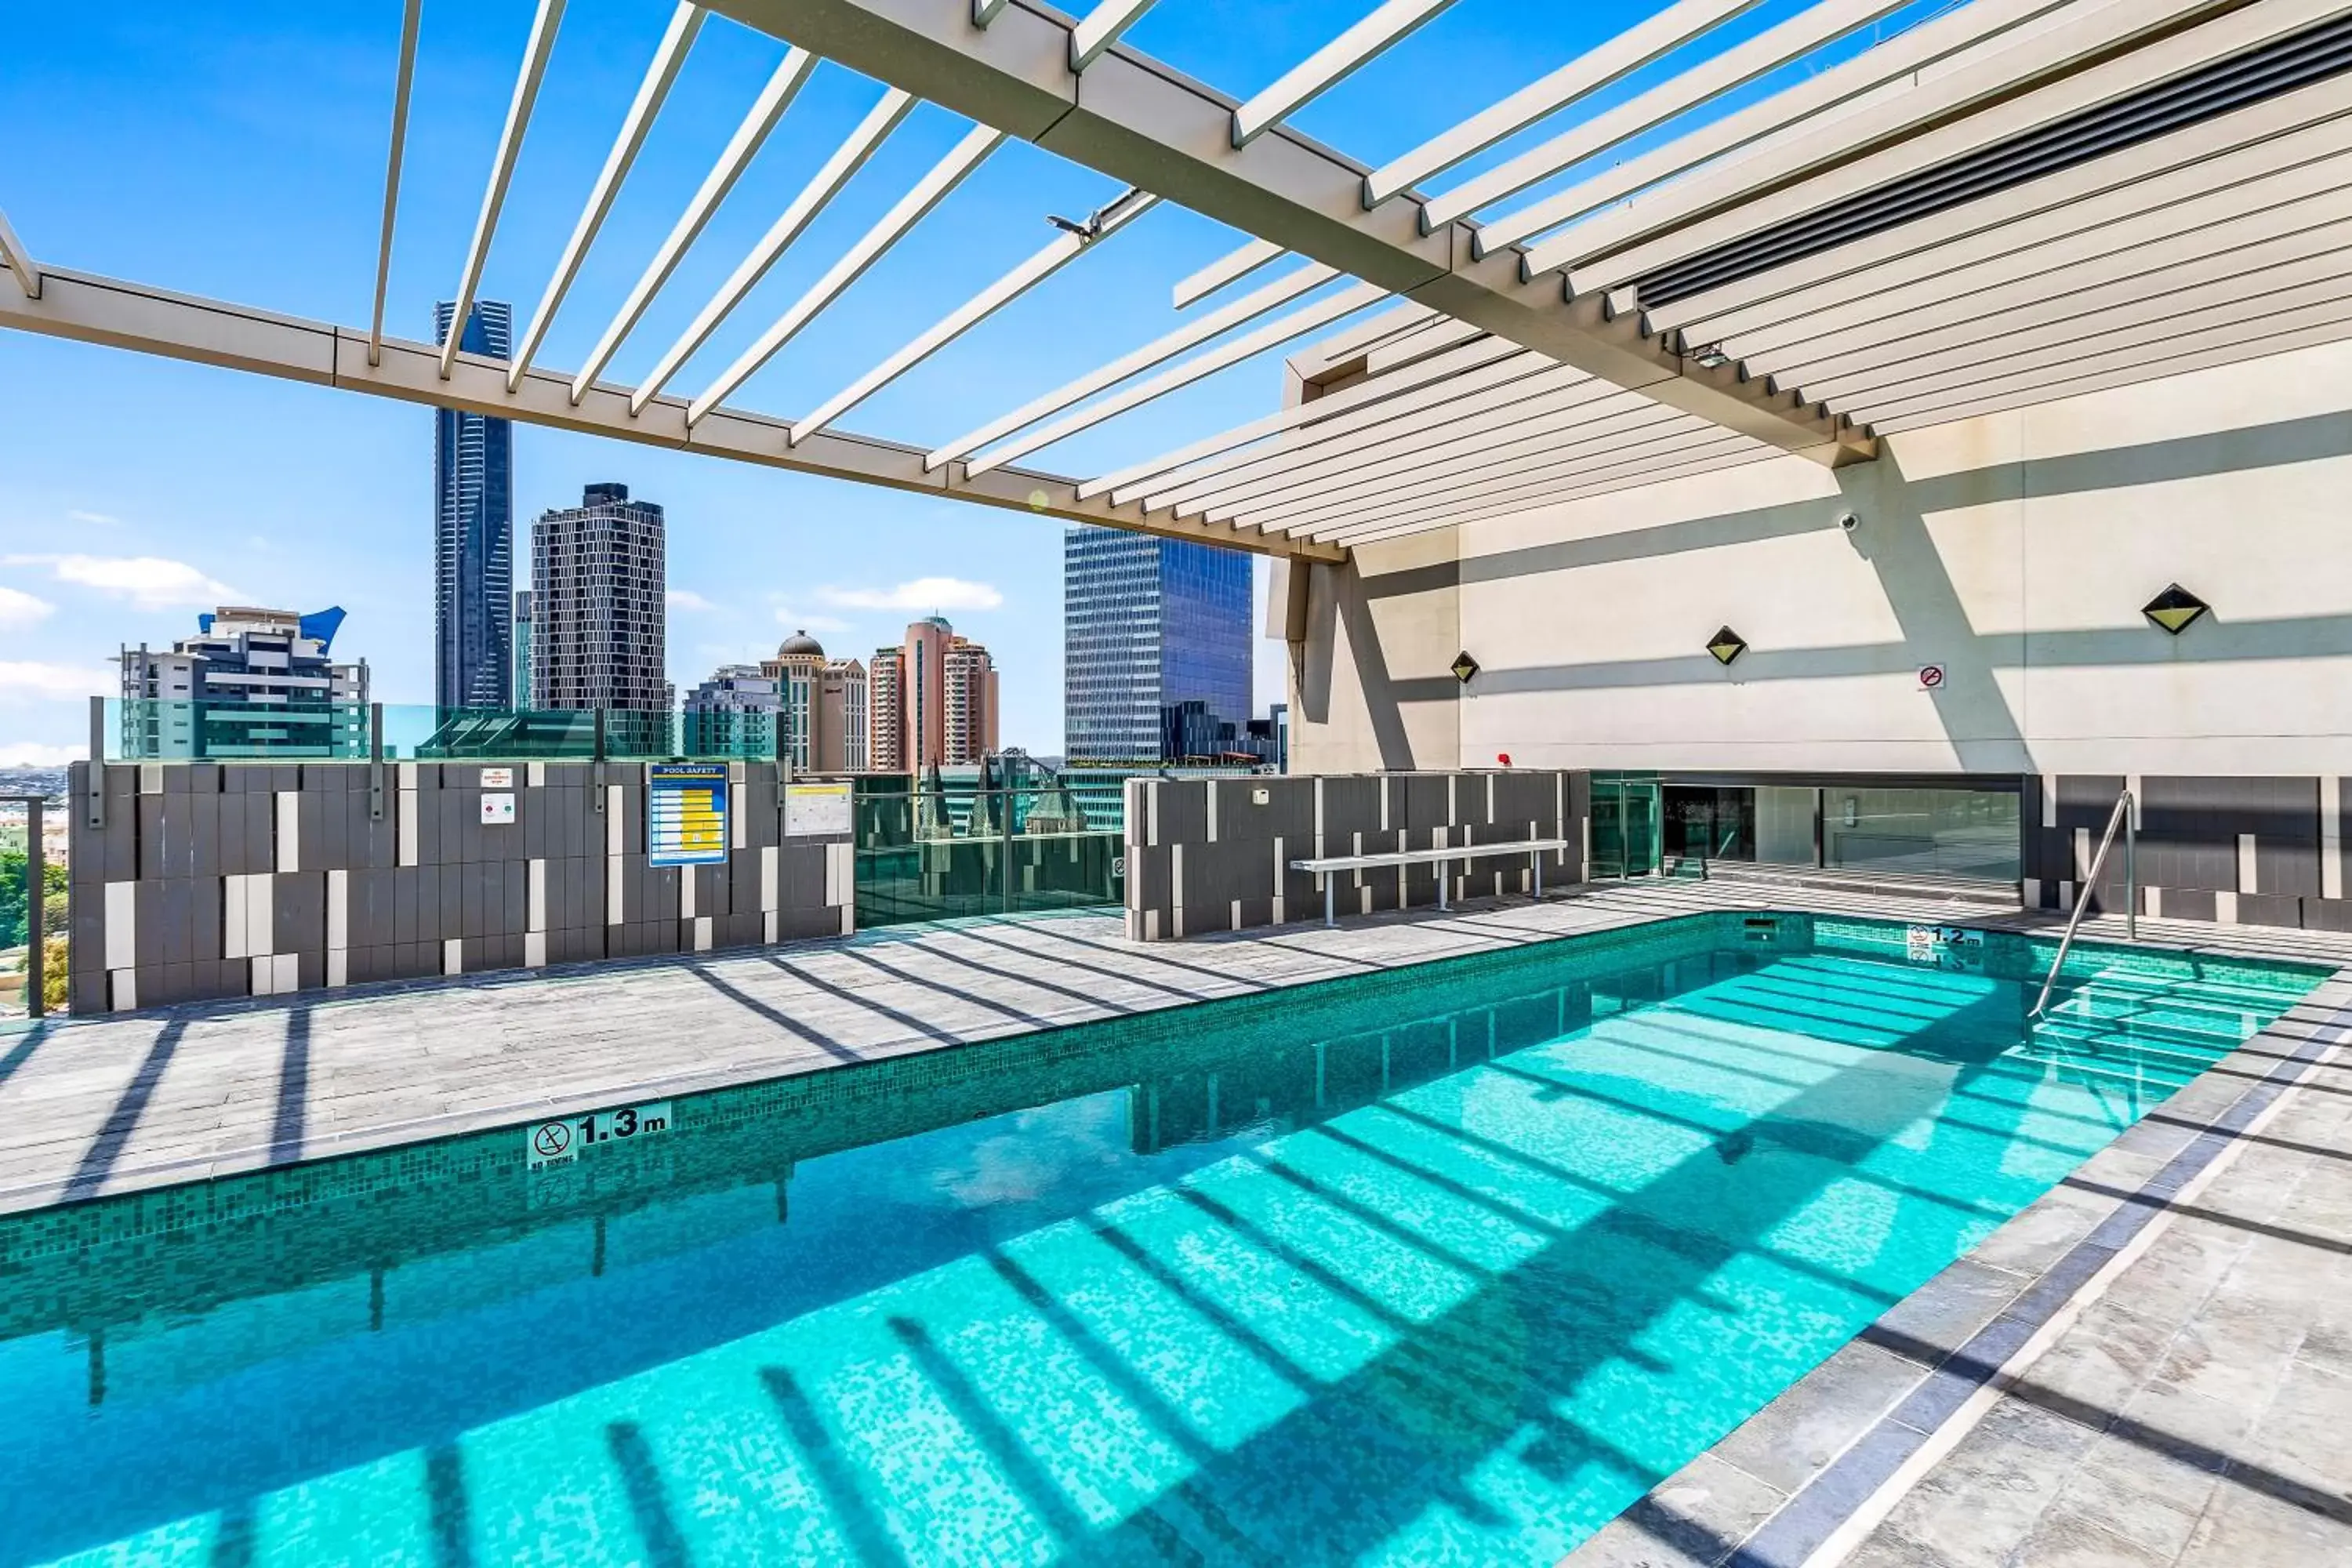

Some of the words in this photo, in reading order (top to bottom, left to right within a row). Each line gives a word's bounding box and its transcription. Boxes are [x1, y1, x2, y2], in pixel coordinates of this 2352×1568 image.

[1932, 928, 1964, 944] 1.2
[579, 1109, 638, 1144] 1.3
[644, 1117, 666, 1132] m
